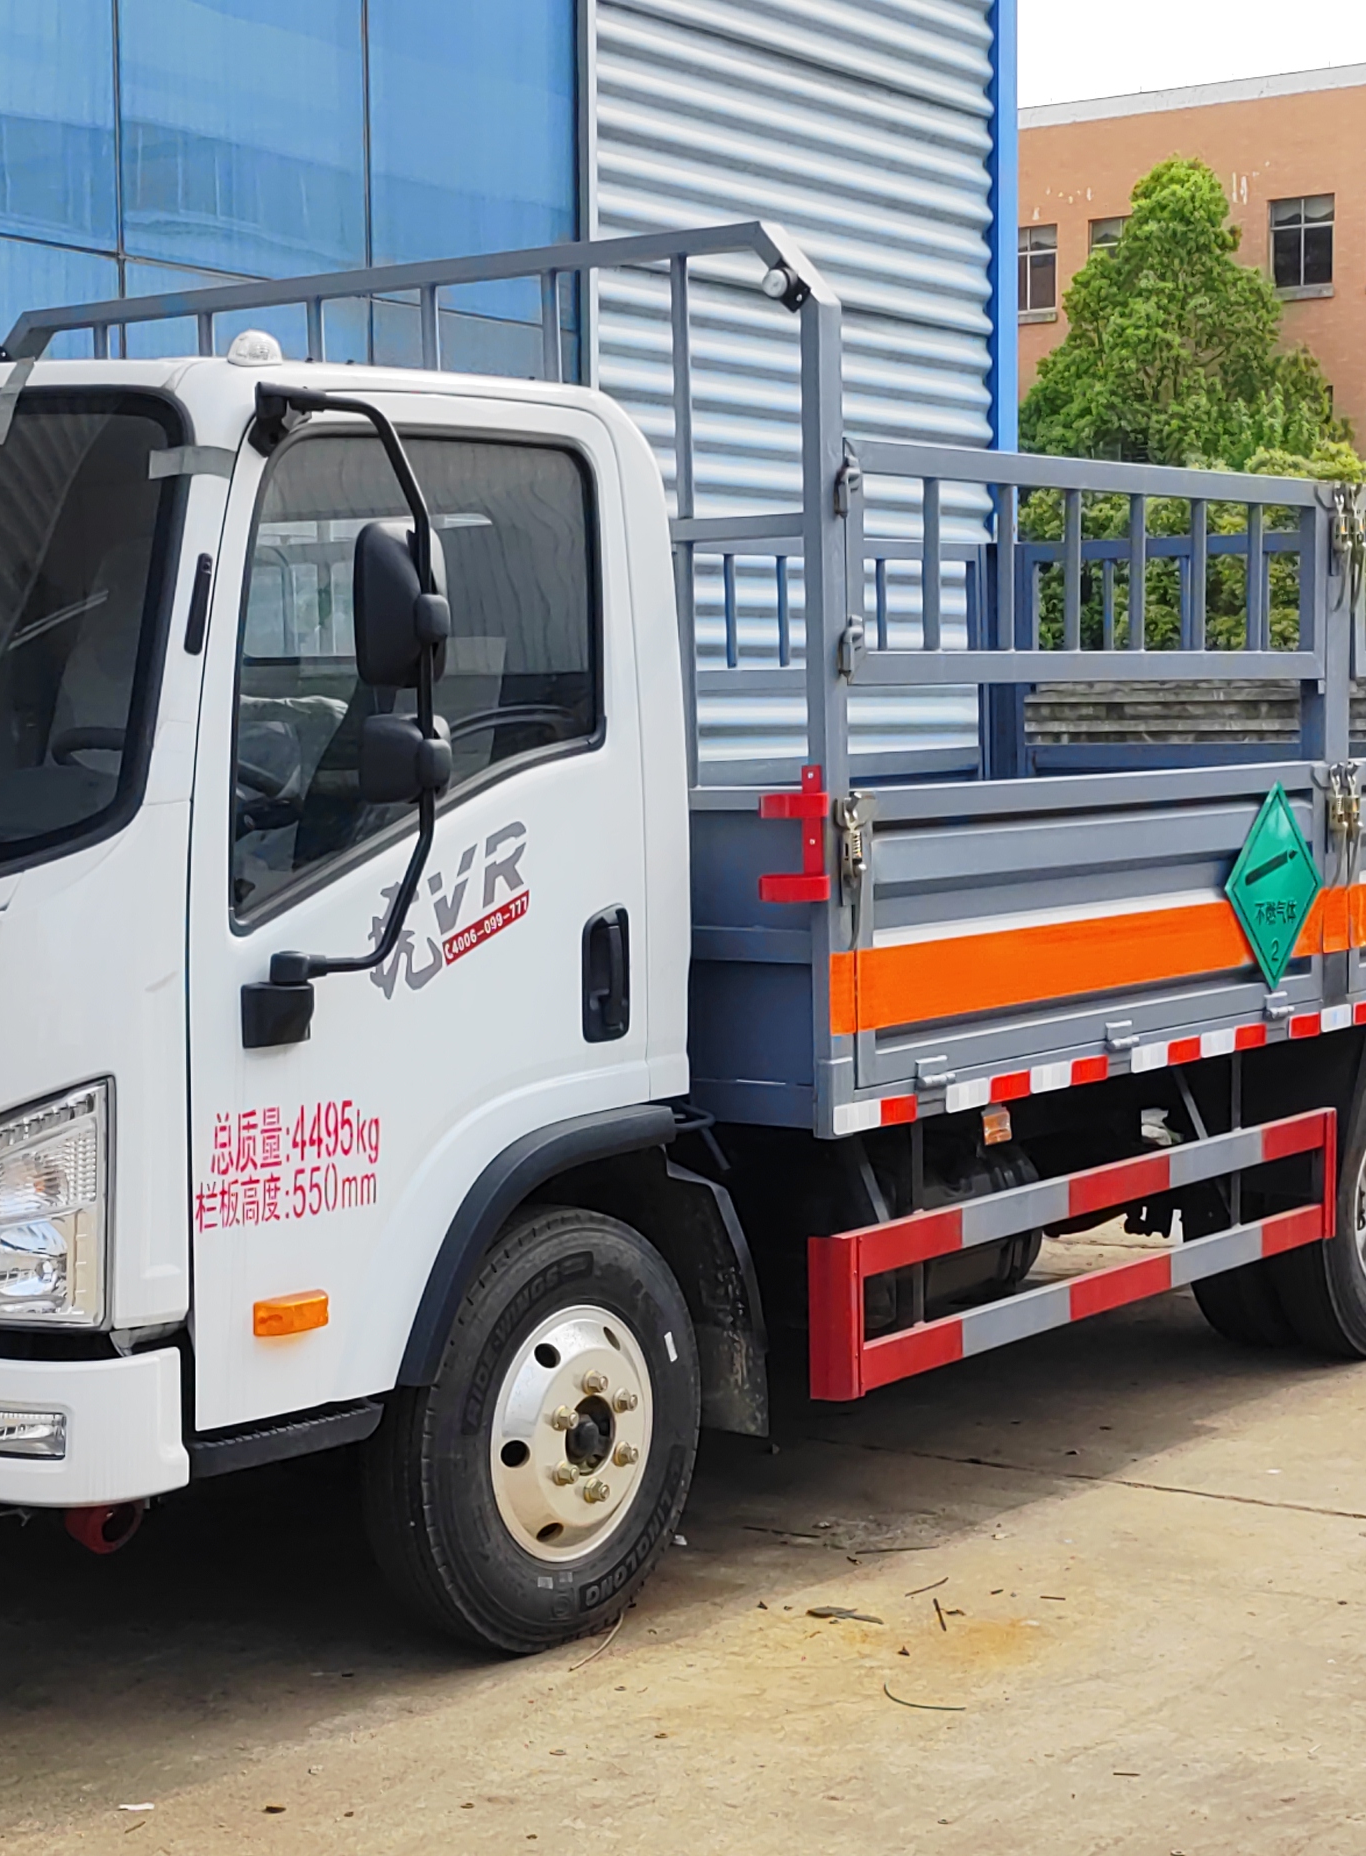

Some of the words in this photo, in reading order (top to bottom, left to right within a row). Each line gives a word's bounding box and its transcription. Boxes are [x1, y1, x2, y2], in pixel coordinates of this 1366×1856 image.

[1254, 899, 1299, 927] 不燃气体
[1270, 939, 1280, 962] 2
